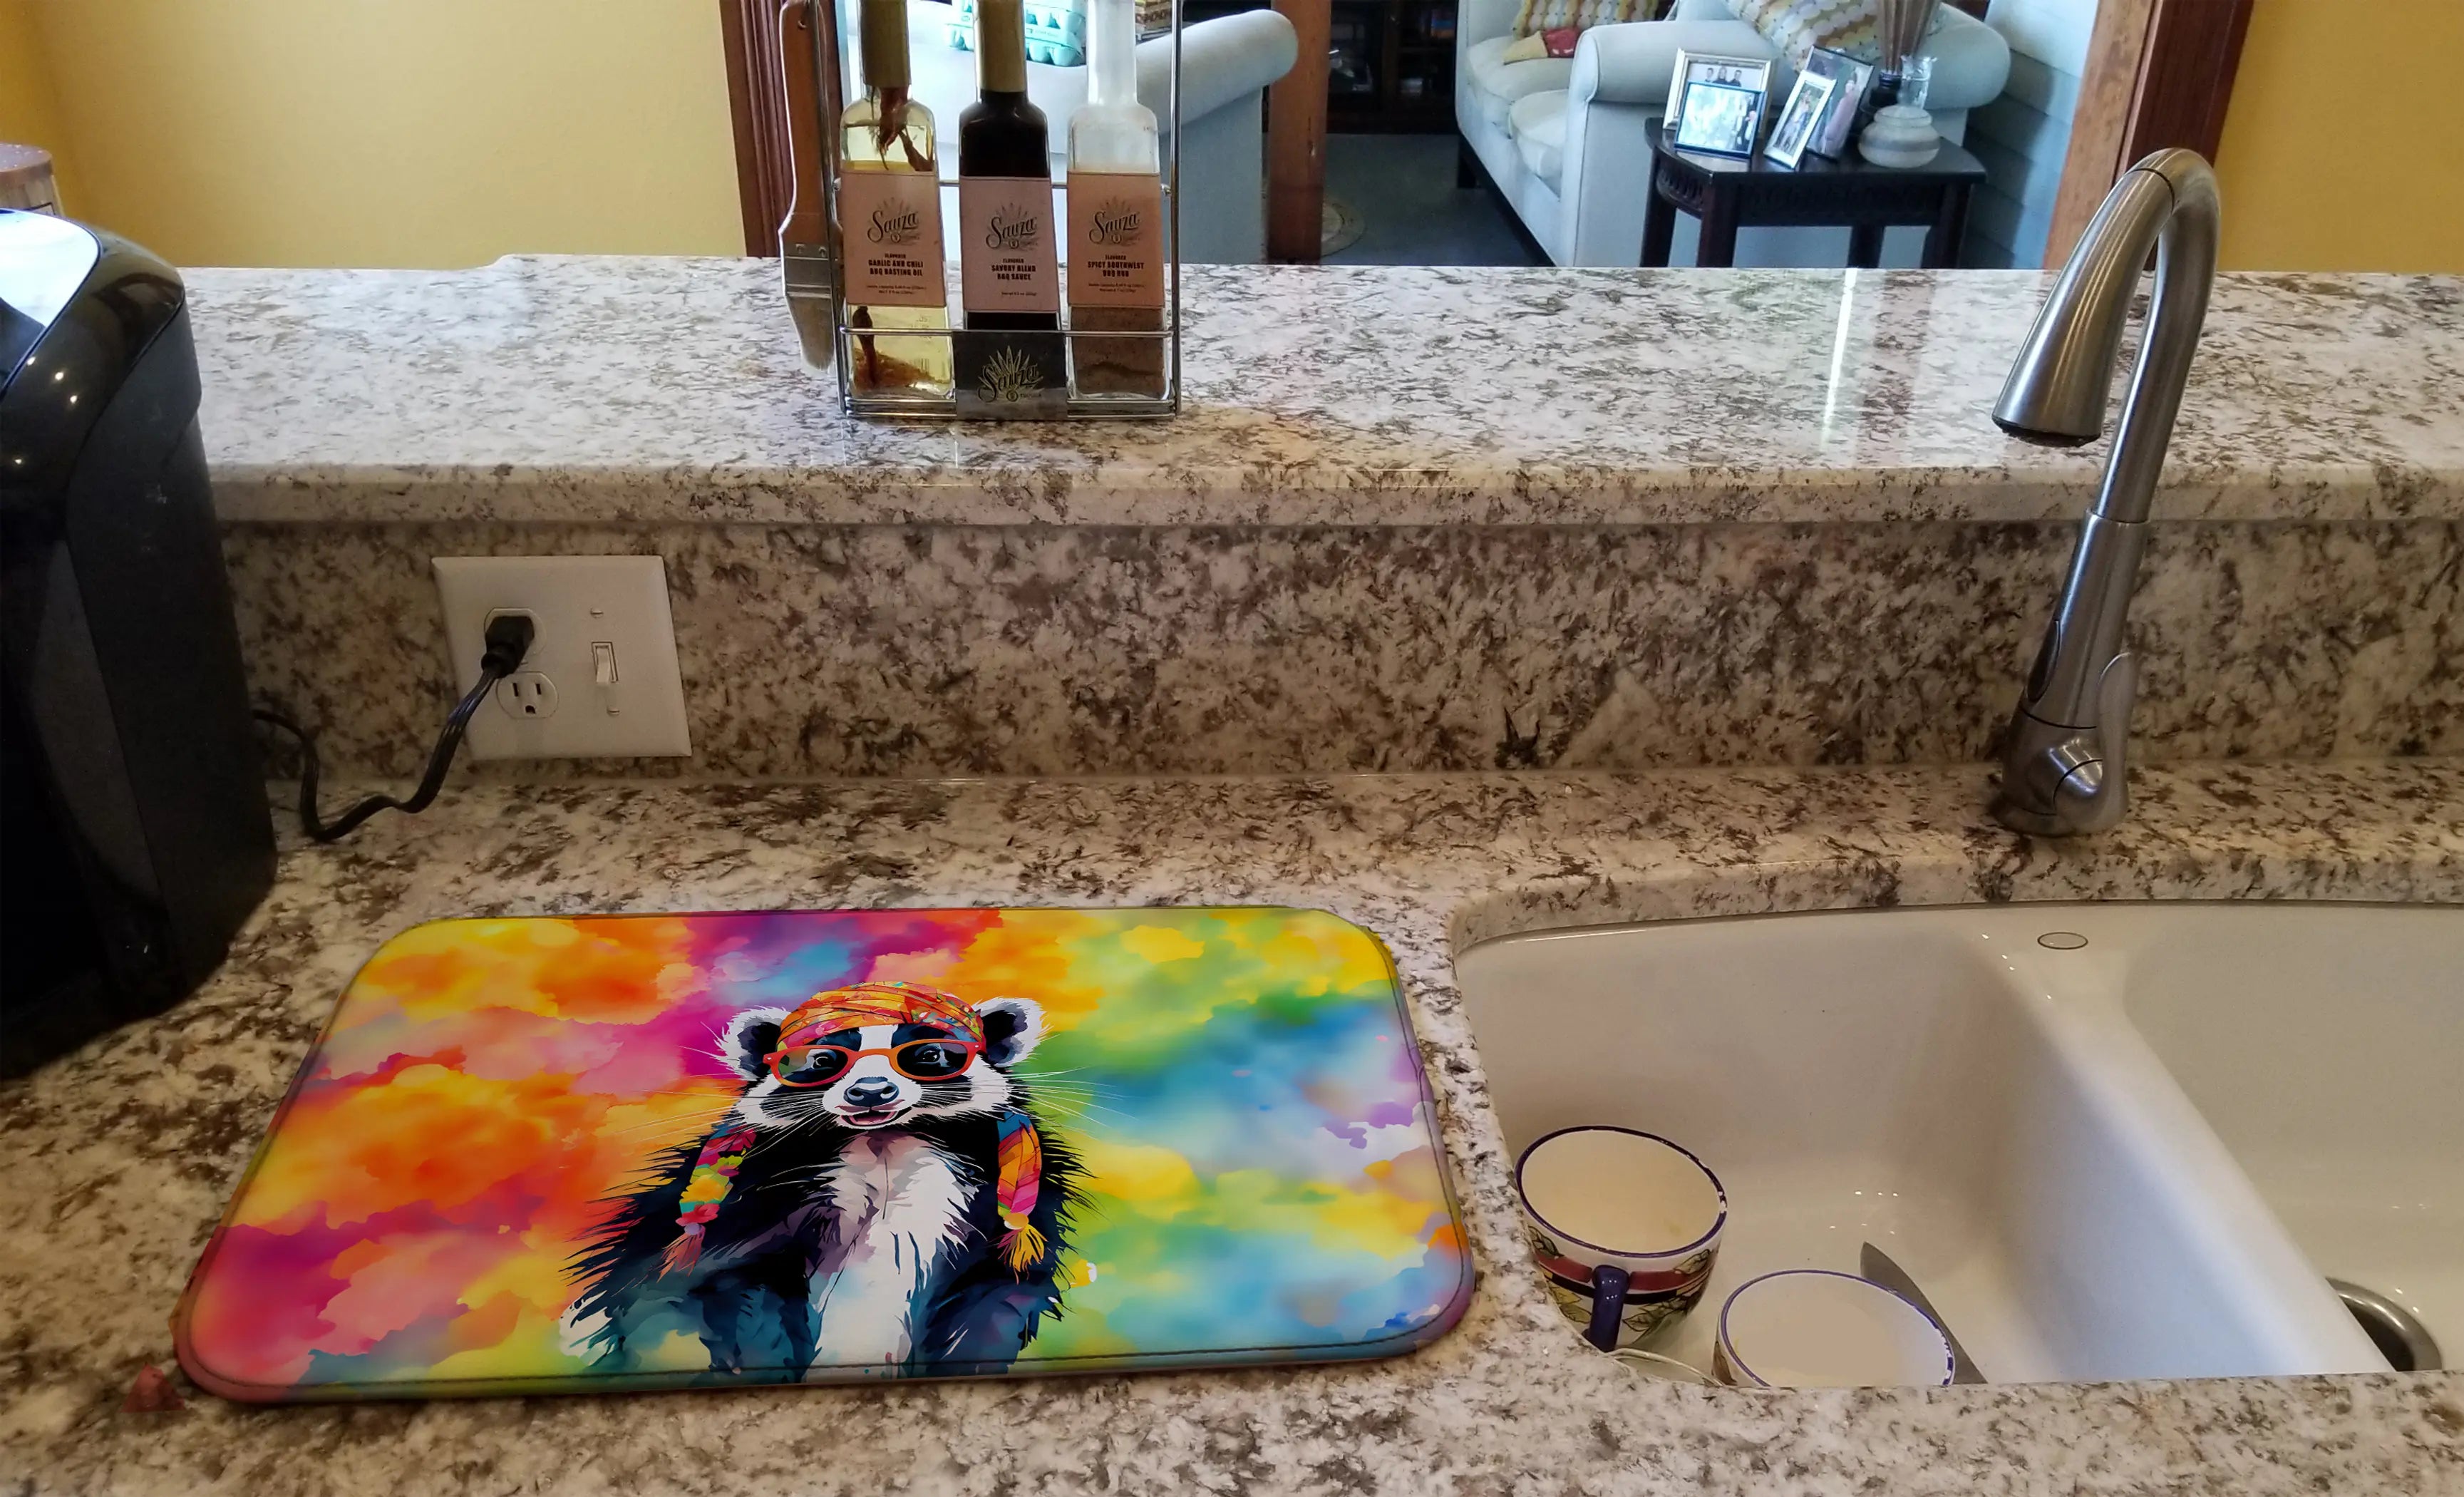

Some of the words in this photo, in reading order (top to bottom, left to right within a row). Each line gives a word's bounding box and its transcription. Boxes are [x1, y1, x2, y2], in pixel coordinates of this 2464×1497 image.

[867, 210, 919, 242] Sauza
[986, 216, 1038, 249] Sauza
[1088, 211, 1141, 245] Sauza
[870, 267, 883, 276] BBQ
[885, 268, 912, 277] BASTING
[1107, 261, 1145, 269] SOUTHWEST
